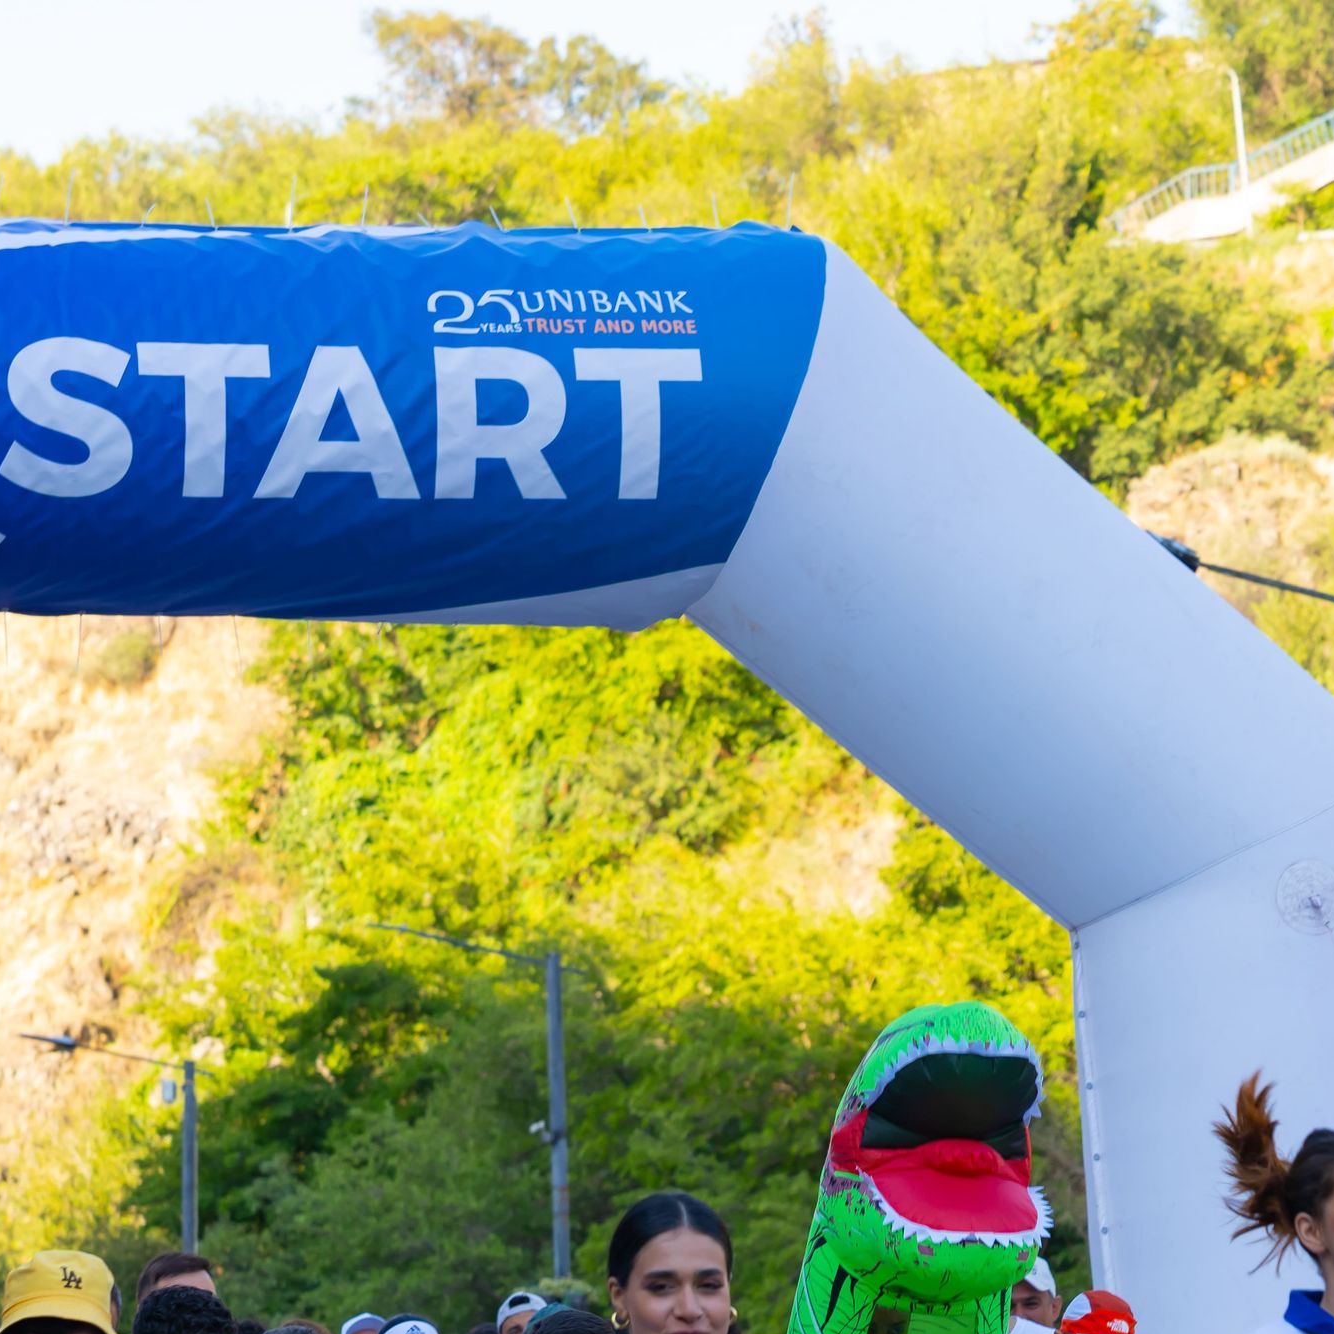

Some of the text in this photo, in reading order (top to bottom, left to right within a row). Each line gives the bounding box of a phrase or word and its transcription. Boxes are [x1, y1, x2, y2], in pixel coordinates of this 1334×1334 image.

[426, 289, 521, 335] 25
[517, 289, 693, 314] UNIBANK
[479, 322, 523, 334] YEARS
[523, 317, 698, 334] TRUST AND MORE
